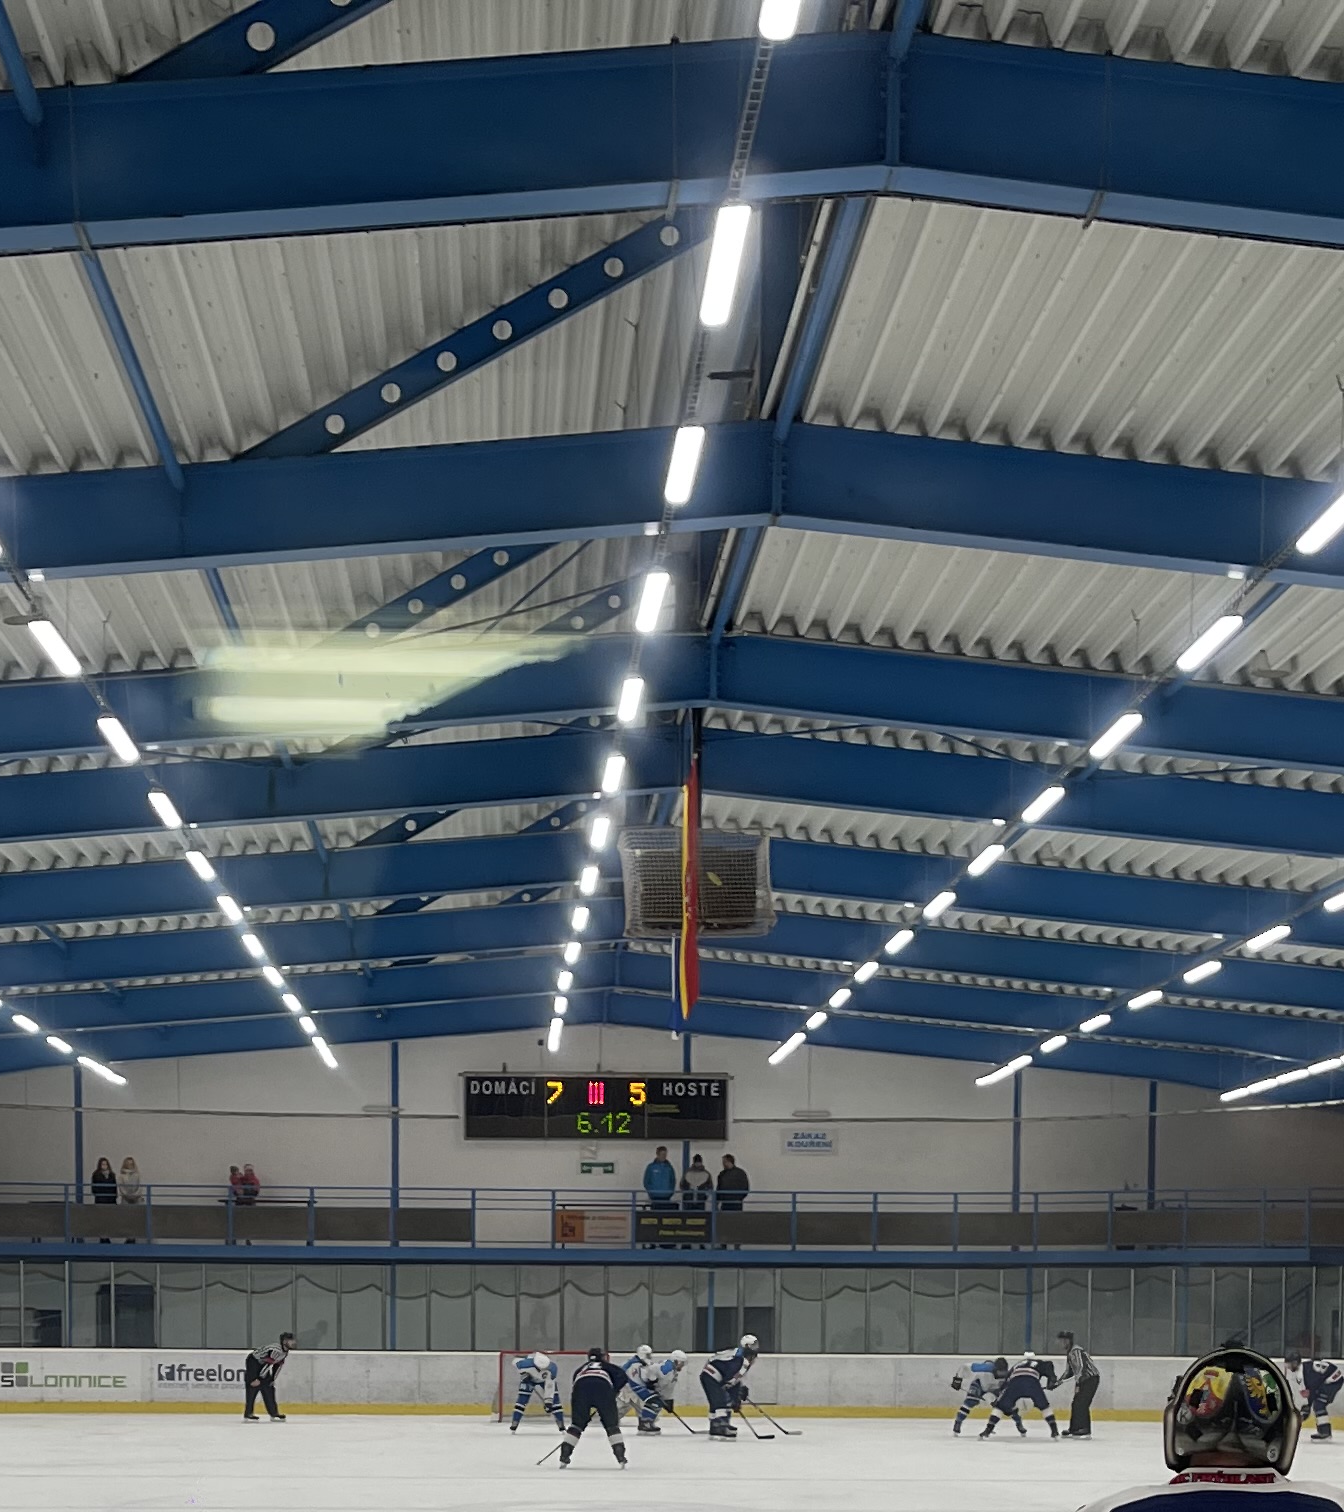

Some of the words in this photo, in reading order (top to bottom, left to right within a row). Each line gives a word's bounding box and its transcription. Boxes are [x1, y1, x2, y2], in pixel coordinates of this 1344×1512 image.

[470, 1078, 536, 1096] DOMÁCÍ
[546, 1081, 563, 1105] 7
[629, 1082, 646, 1105] 5
